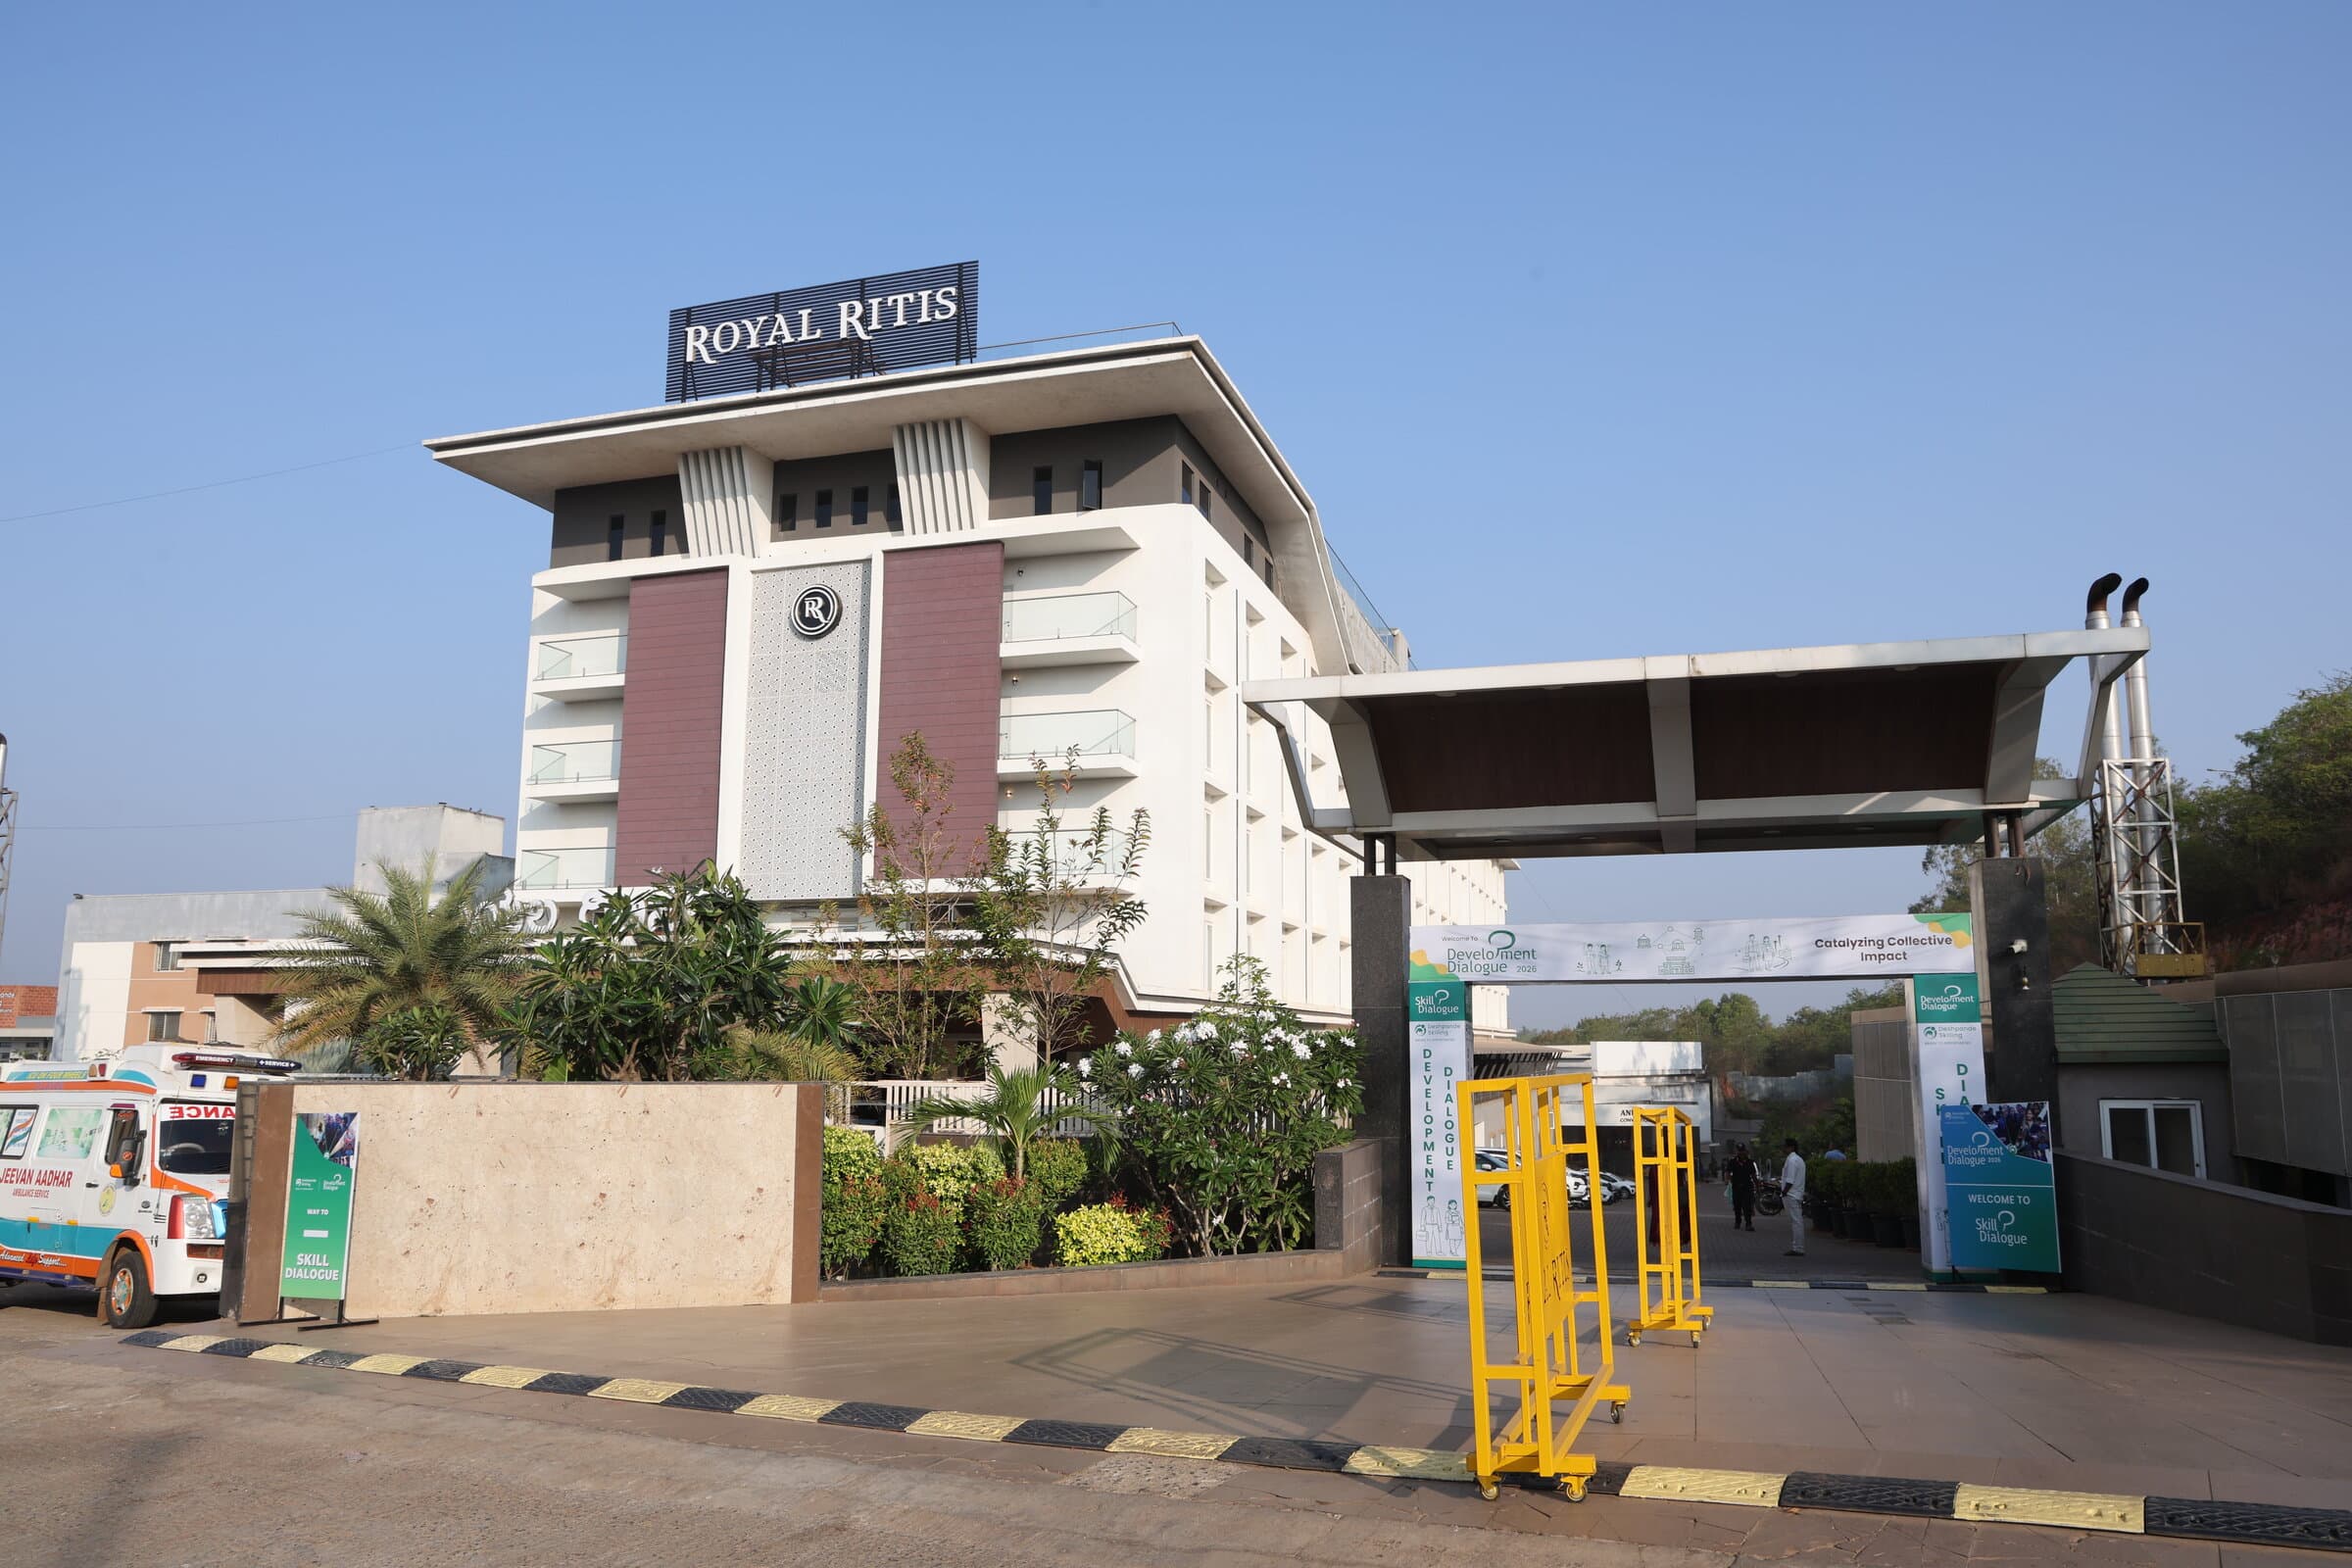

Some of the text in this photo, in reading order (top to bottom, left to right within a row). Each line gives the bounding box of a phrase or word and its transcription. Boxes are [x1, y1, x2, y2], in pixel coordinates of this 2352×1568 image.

[685, 286, 958, 364] ROYAL RITIS
[1815, 935, 1953, 950] Catalyzing Collective
[1861, 951, 1907, 963] Impact
[1447, 961, 1507, 975] Dialogue
[1415, 996, 1434, 1005] Skill
[1921, 1003, 1958, 1011] Dialogue
[1418, 1004, 1459, 1014] Dialogue
[1423, 1049, 1435, 1192] DEVELOPMENT
[1444, 1066, 1455, 1170] DIALOGUE
[1948, 1155, 1986, 1167] Dialogue
[35, 1169, 74, 1188] AADHAR
[1968, 1194, 2031, 1205] WELCOME TO
[1976, 1218, 1998, 1231] Skill
[1980, 1231, 2028, 1247] Dialogue
[297, 1253, 329, 1266] SKILL
[285, 1268, 339, 1280] DIALOGUE
